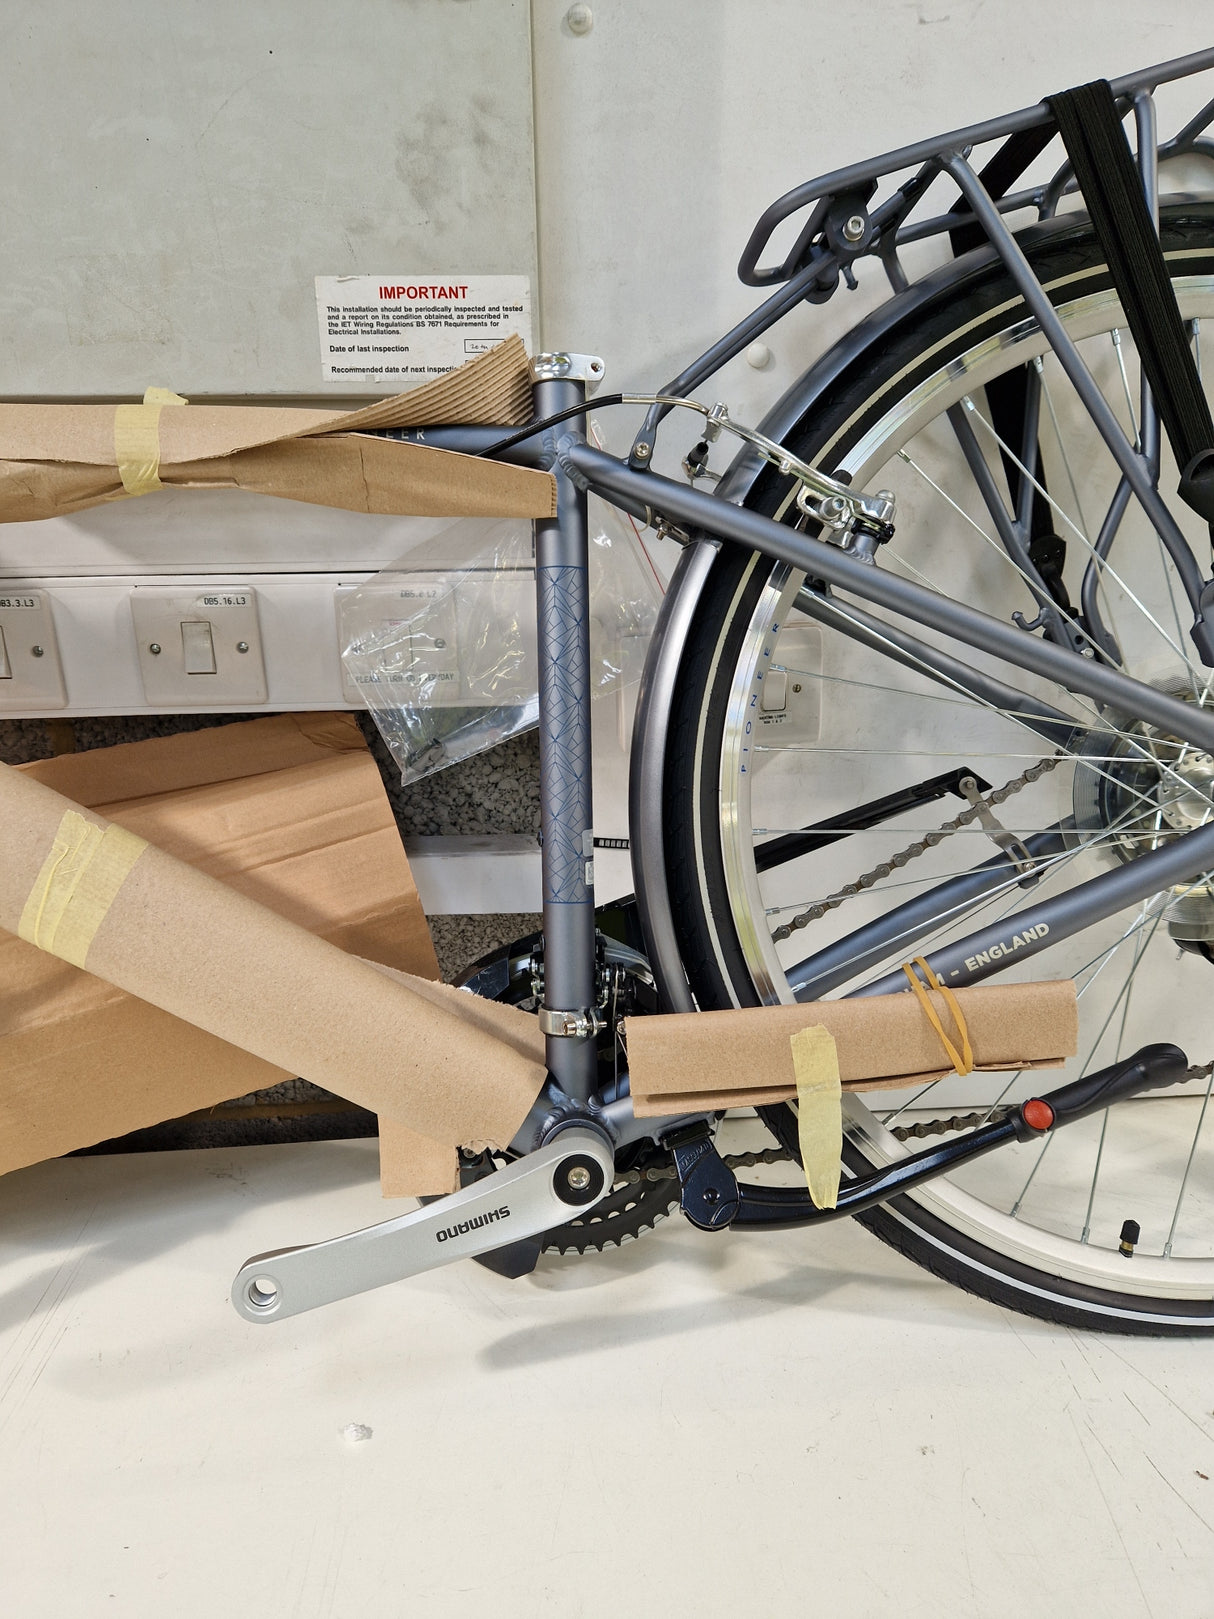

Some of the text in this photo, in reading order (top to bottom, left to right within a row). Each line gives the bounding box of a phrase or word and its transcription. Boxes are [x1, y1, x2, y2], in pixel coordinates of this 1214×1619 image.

[379, 286, 468, 299] IMPORTANT
[415, 306, 451, 314] periodically
[467, 313, 501, 321] prescribed
[444, 320, 487, 328] Requirements
[372, 345, 409, 353] inspection
[427, 366, 457, 374] inspecti
[740, 623, 780, 773] PIONEER
[964, 923, 1050, 972] ENGLAND
[436, 1205, 511, 1243] SHIMANO
